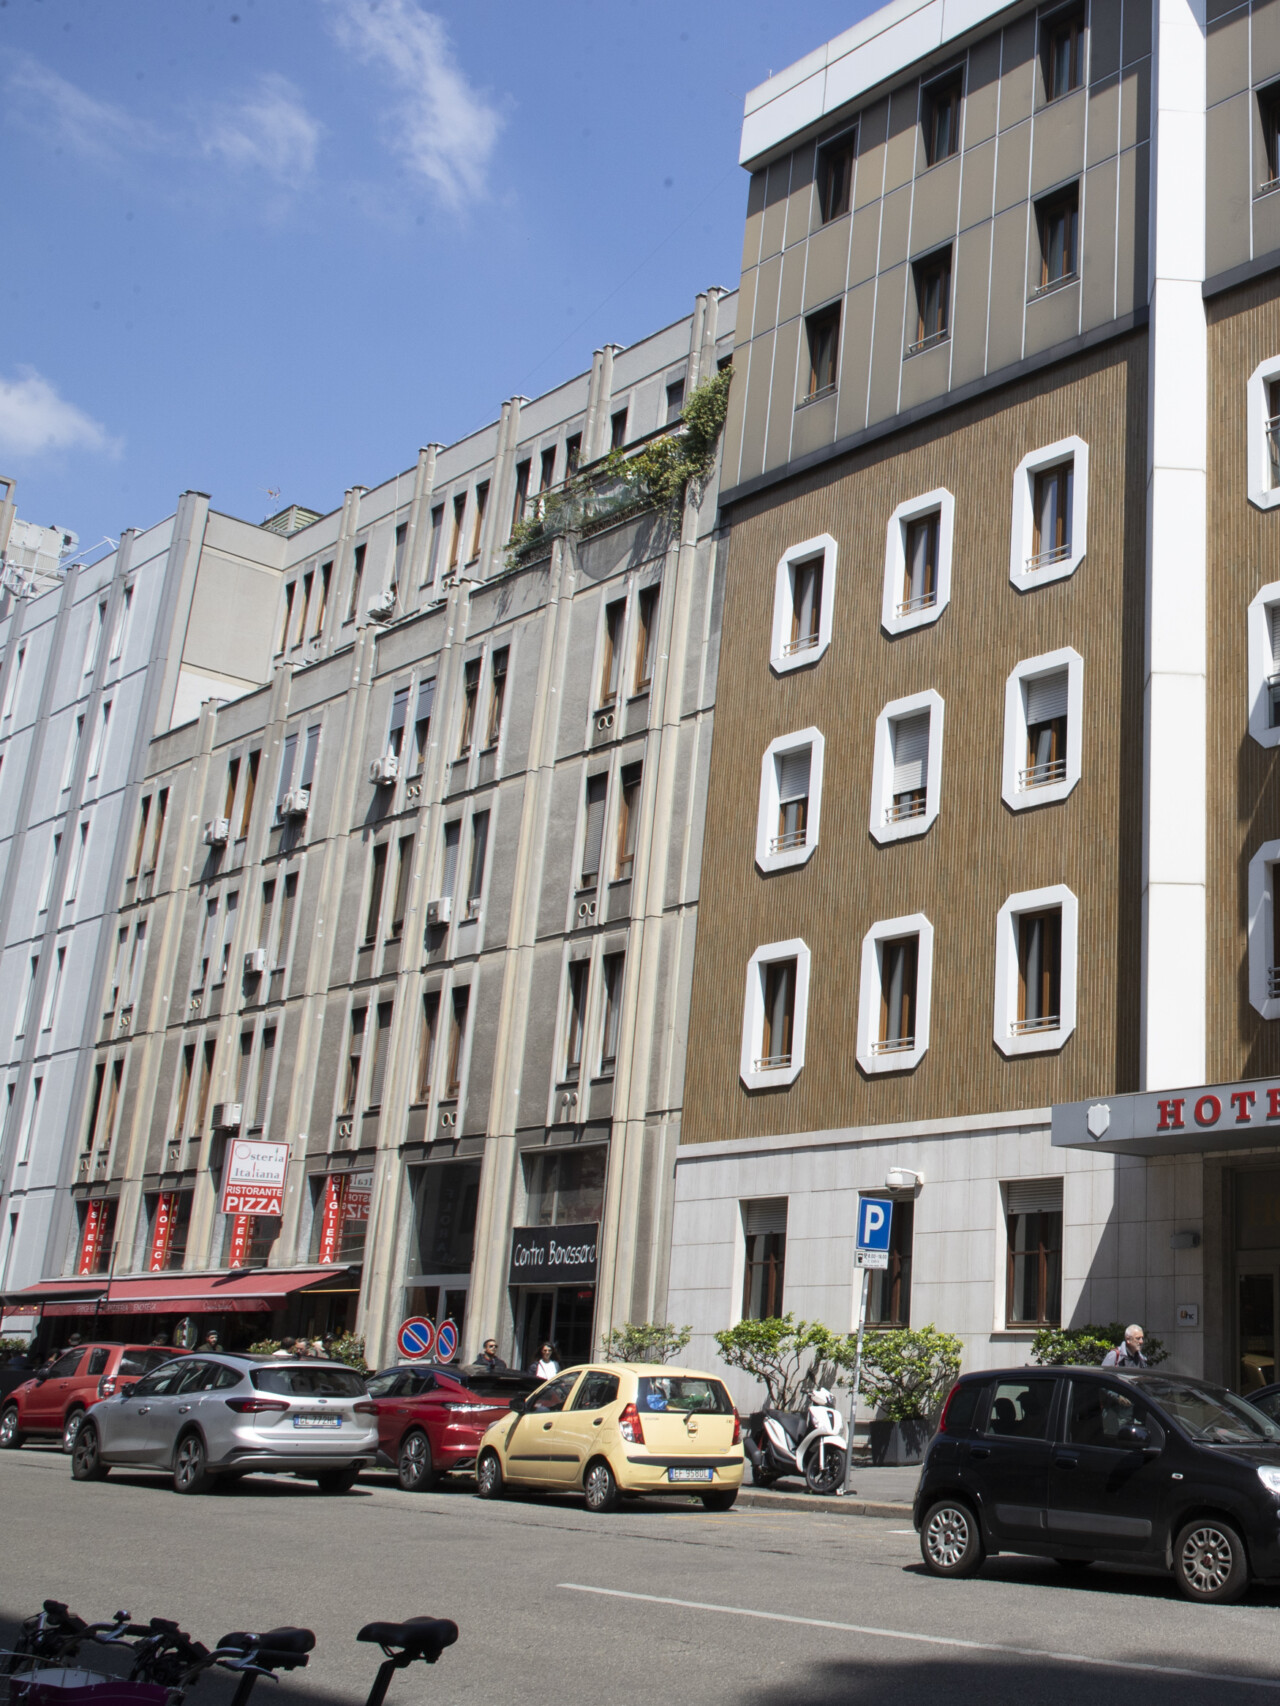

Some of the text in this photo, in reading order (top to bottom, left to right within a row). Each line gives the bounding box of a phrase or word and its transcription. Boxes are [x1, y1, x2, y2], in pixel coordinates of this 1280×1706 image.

[235, 1143, 284, 1163] Osteria
[235, 1162, 280, 1180] Italiana
[225, 1196, 281, 1214] PIZZA
[226, 1186, 283, 1197] RISTORANTE
[152, 1193, 171, 1271] ENOTECA
[322, 1175, 342, 1263] GRIGLIERIA
[864, 1204, 884, 1244] P
[81, 1200, 100, 1275] OSTERIA
[231, 1216, 246, 1268] ZERIA
[514, 1240, 597, 1266] Centro Benessere
